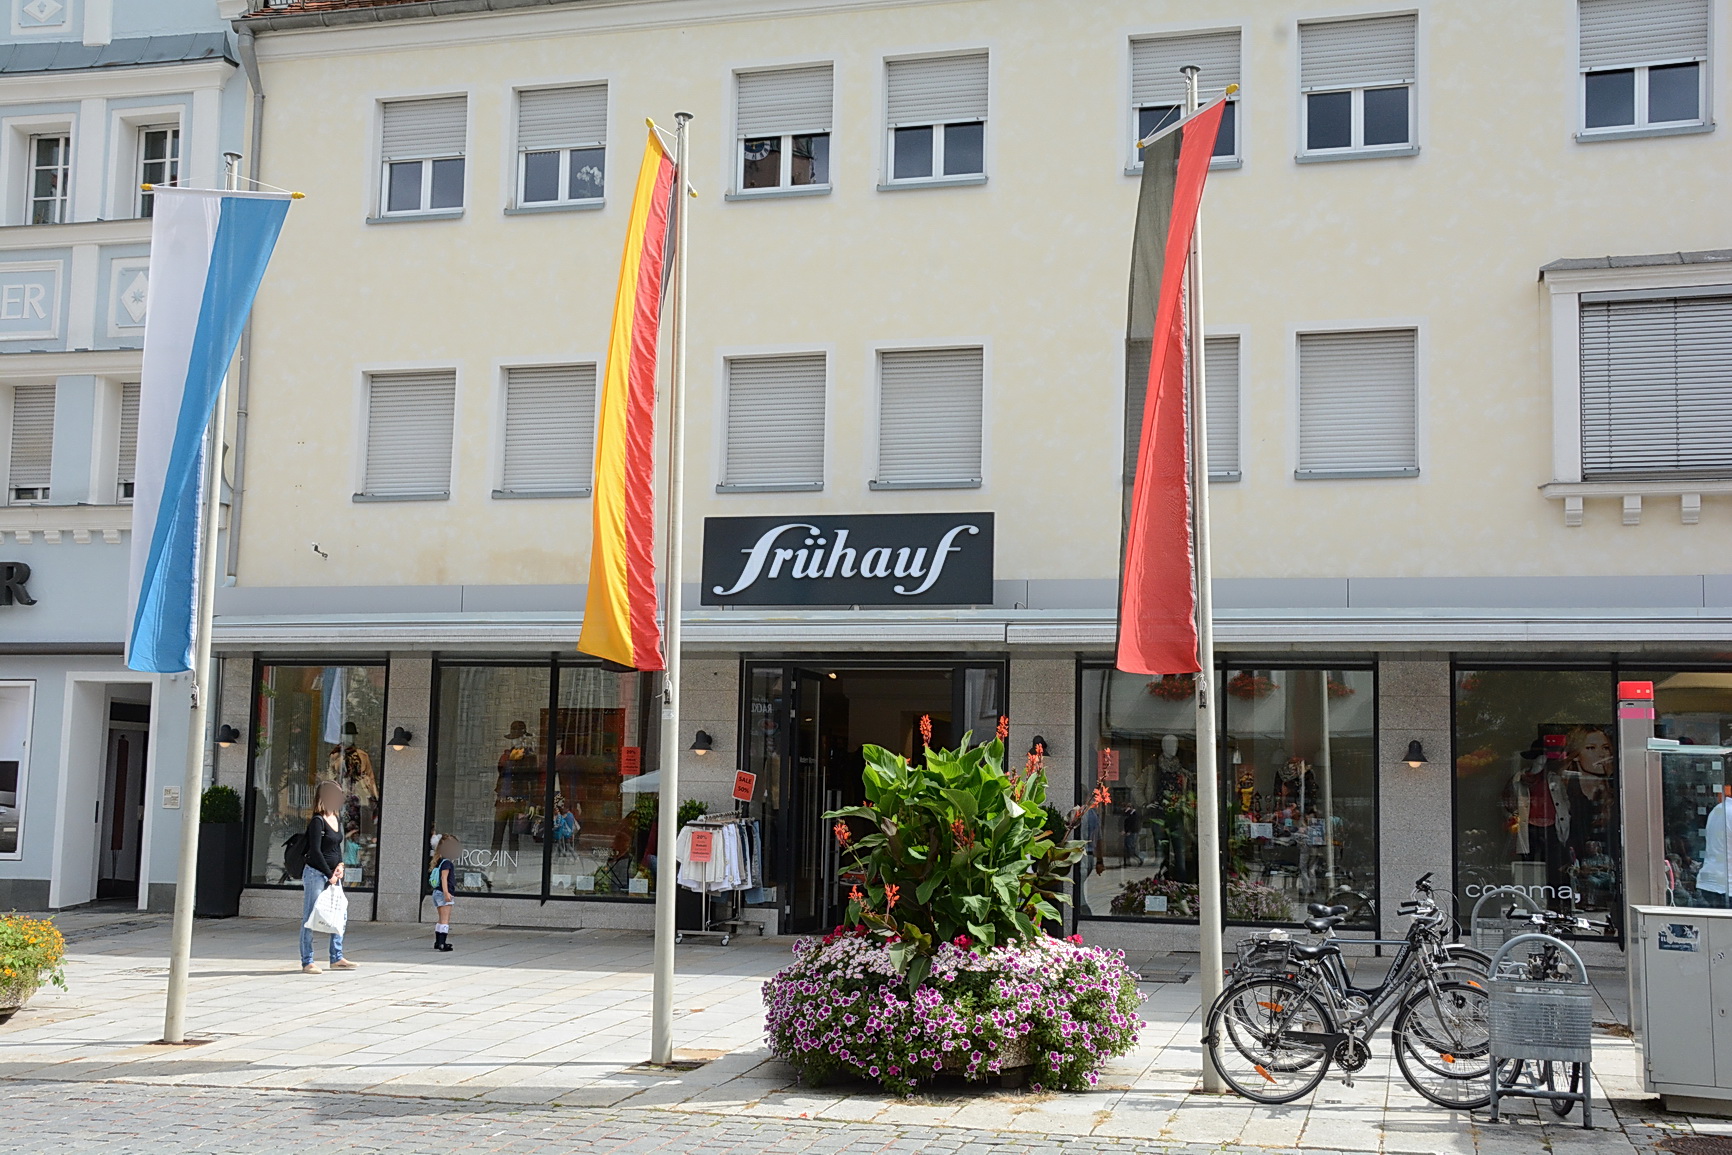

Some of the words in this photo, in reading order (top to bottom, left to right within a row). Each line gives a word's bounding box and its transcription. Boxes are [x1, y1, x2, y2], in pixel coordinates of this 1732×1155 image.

[1, 283, 47, 319] ER
[712, 523, 980, 595] frühauf
[737, 785, 749, 794] 50%
[738, 775, 752, 785] SALE
[1465, 884, 1581, 903] comma,
